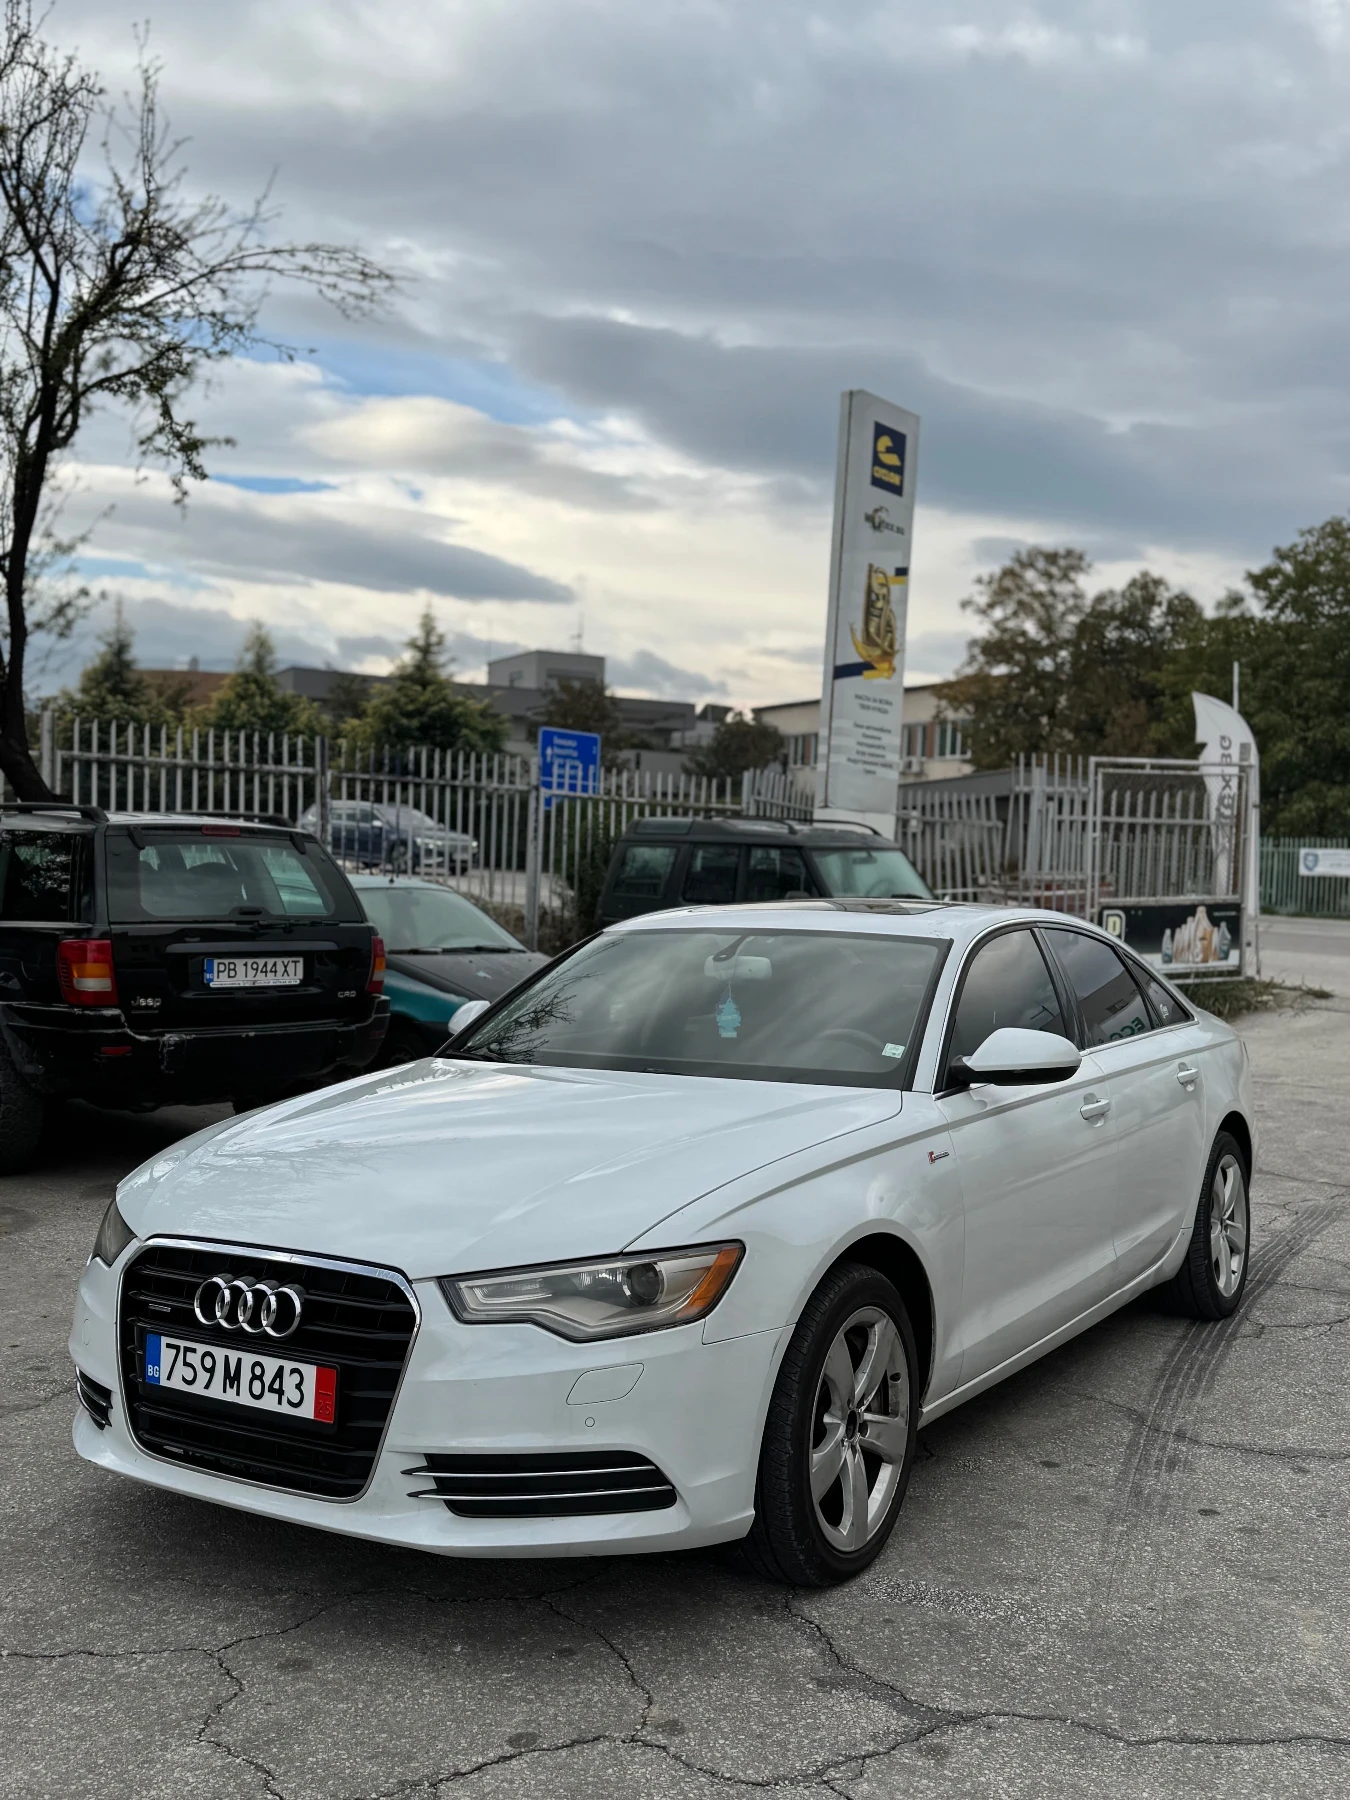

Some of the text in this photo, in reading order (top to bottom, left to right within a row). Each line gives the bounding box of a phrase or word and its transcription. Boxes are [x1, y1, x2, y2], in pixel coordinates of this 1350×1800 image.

[216, 960, 301, 979] PB 1944 XT
[130, 995, 162, 1008] Jeep
[147, 1364, 160, 1378] BG
[165, 1342, 305, 1409] 759 M 843
